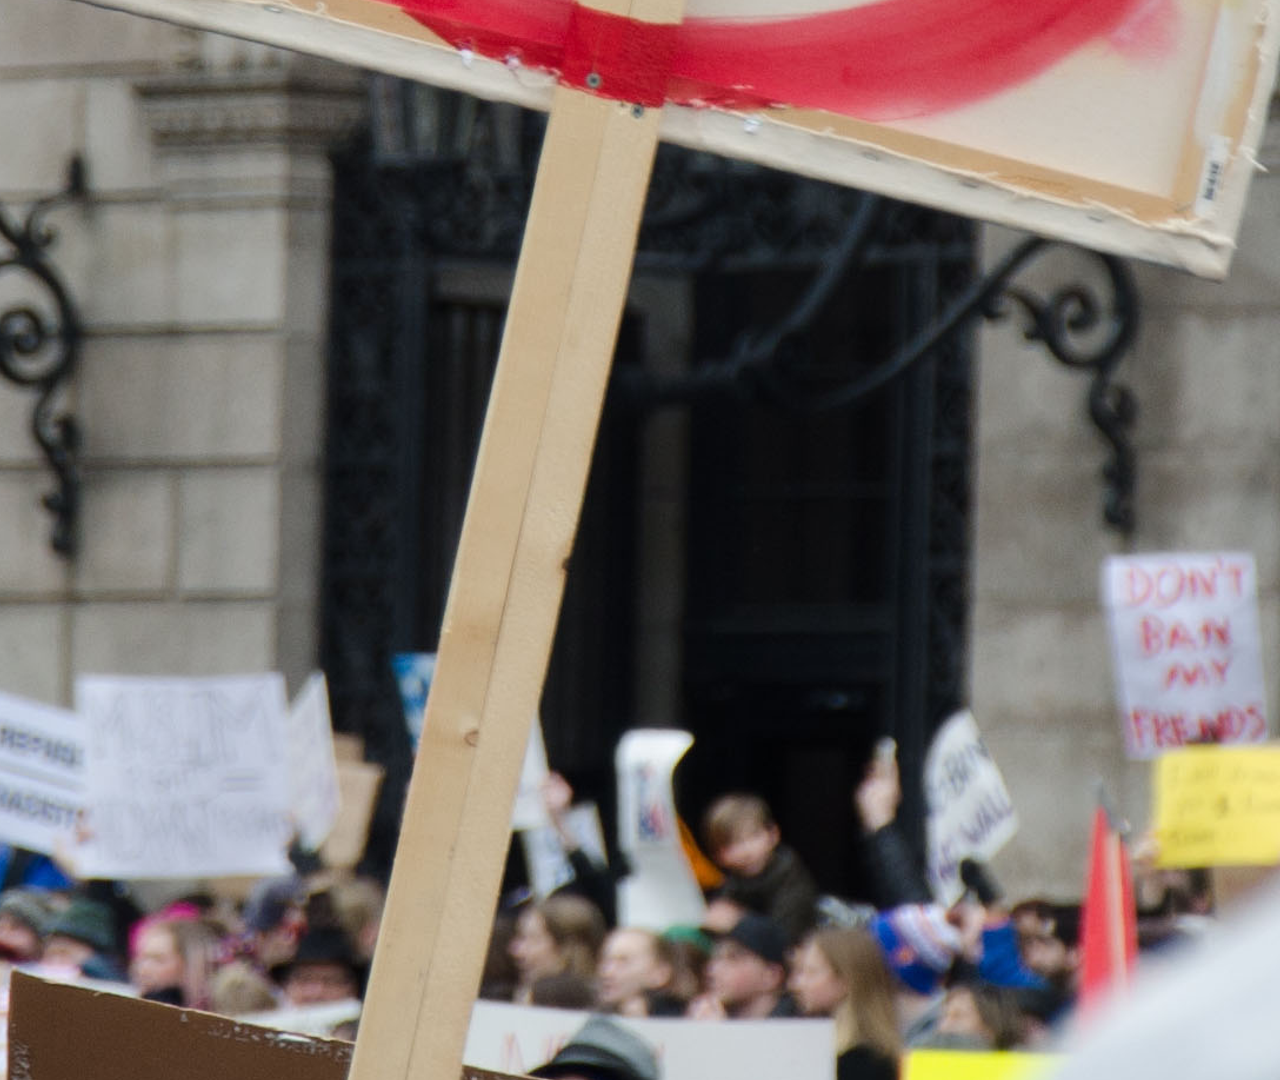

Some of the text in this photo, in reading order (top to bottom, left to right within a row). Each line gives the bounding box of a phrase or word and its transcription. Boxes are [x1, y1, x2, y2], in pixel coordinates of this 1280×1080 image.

[1124, 558, 1243, 608] DON'T
[1137, 615, 1232, 658] BAN
[1162, 657, 1232, 691] MY
